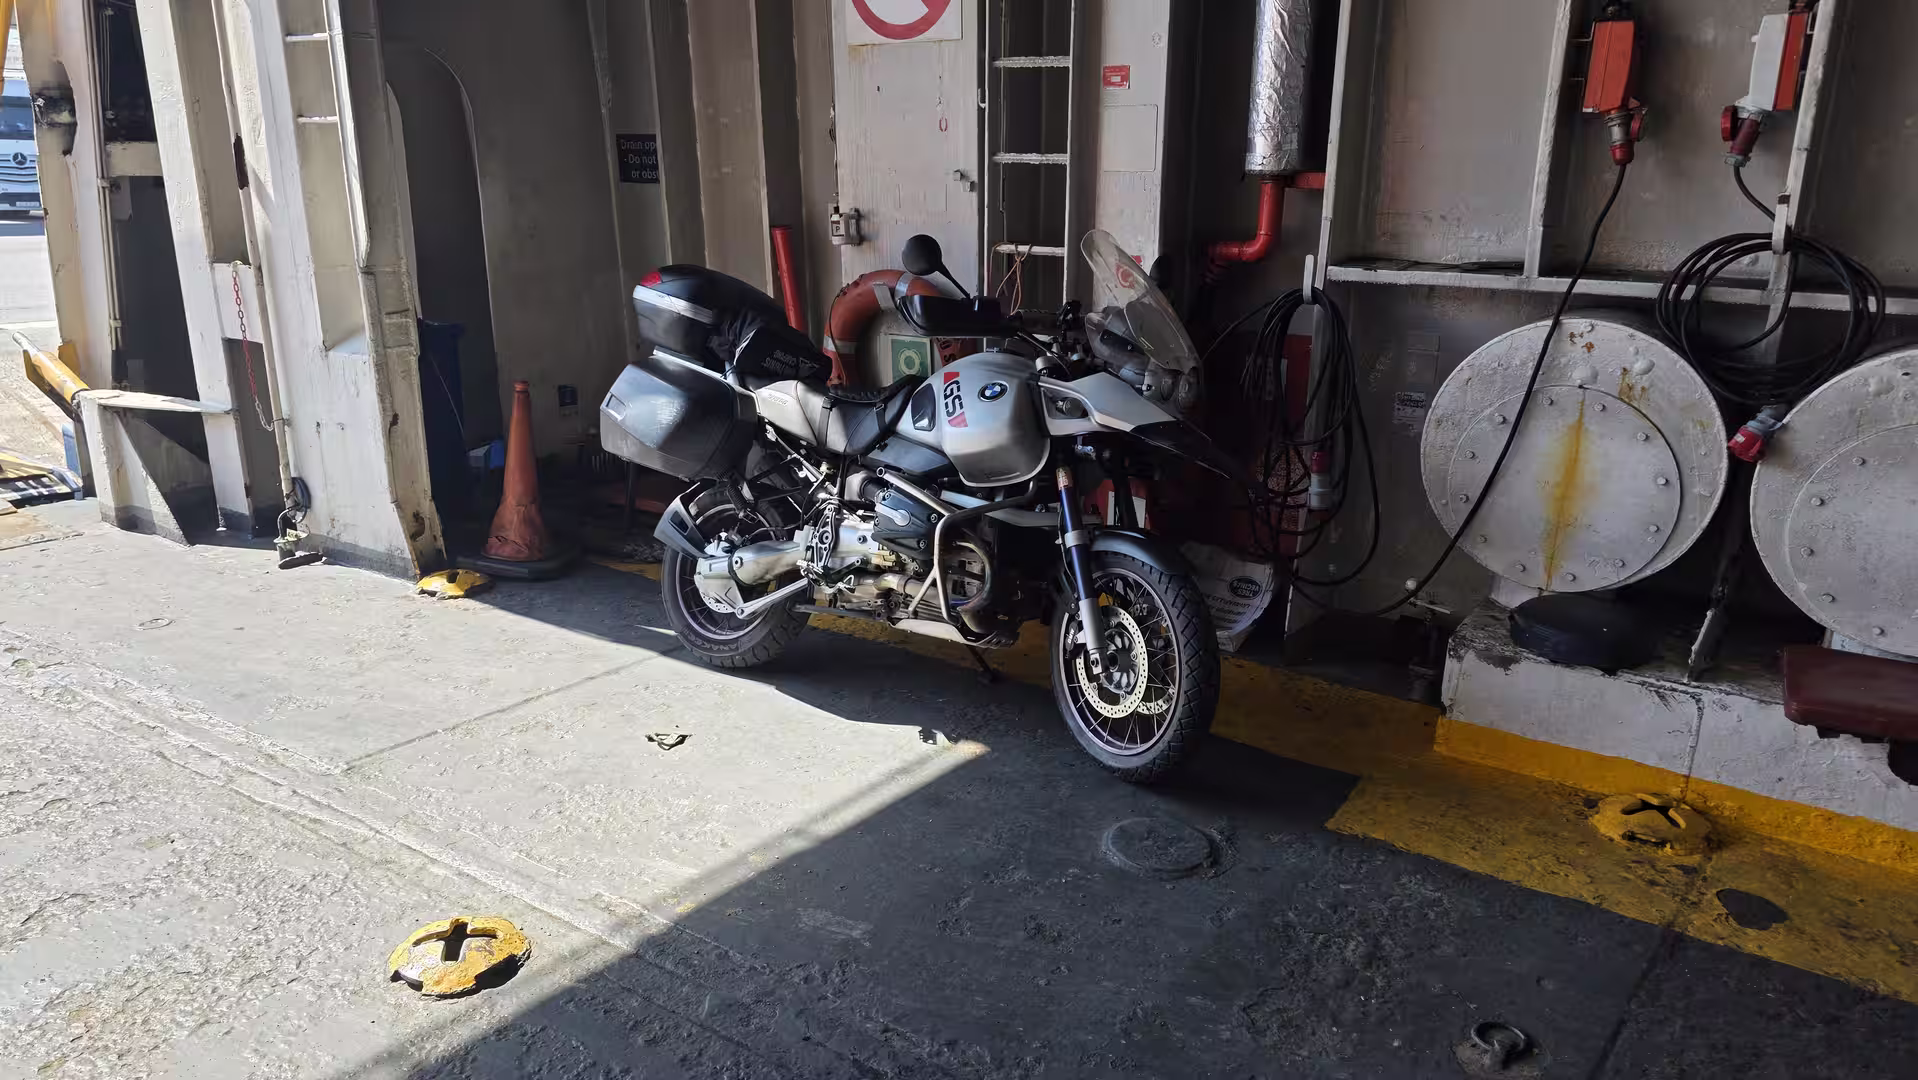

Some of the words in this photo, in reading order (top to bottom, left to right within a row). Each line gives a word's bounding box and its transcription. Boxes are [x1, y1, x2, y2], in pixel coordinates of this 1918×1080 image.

[644, 141, 657, 152] op
[628, 153, 641, 164] Do
[642, 153, 657, 165] not
[631, 169, 640, 179] or
[943, 379, 964, 418] GS
